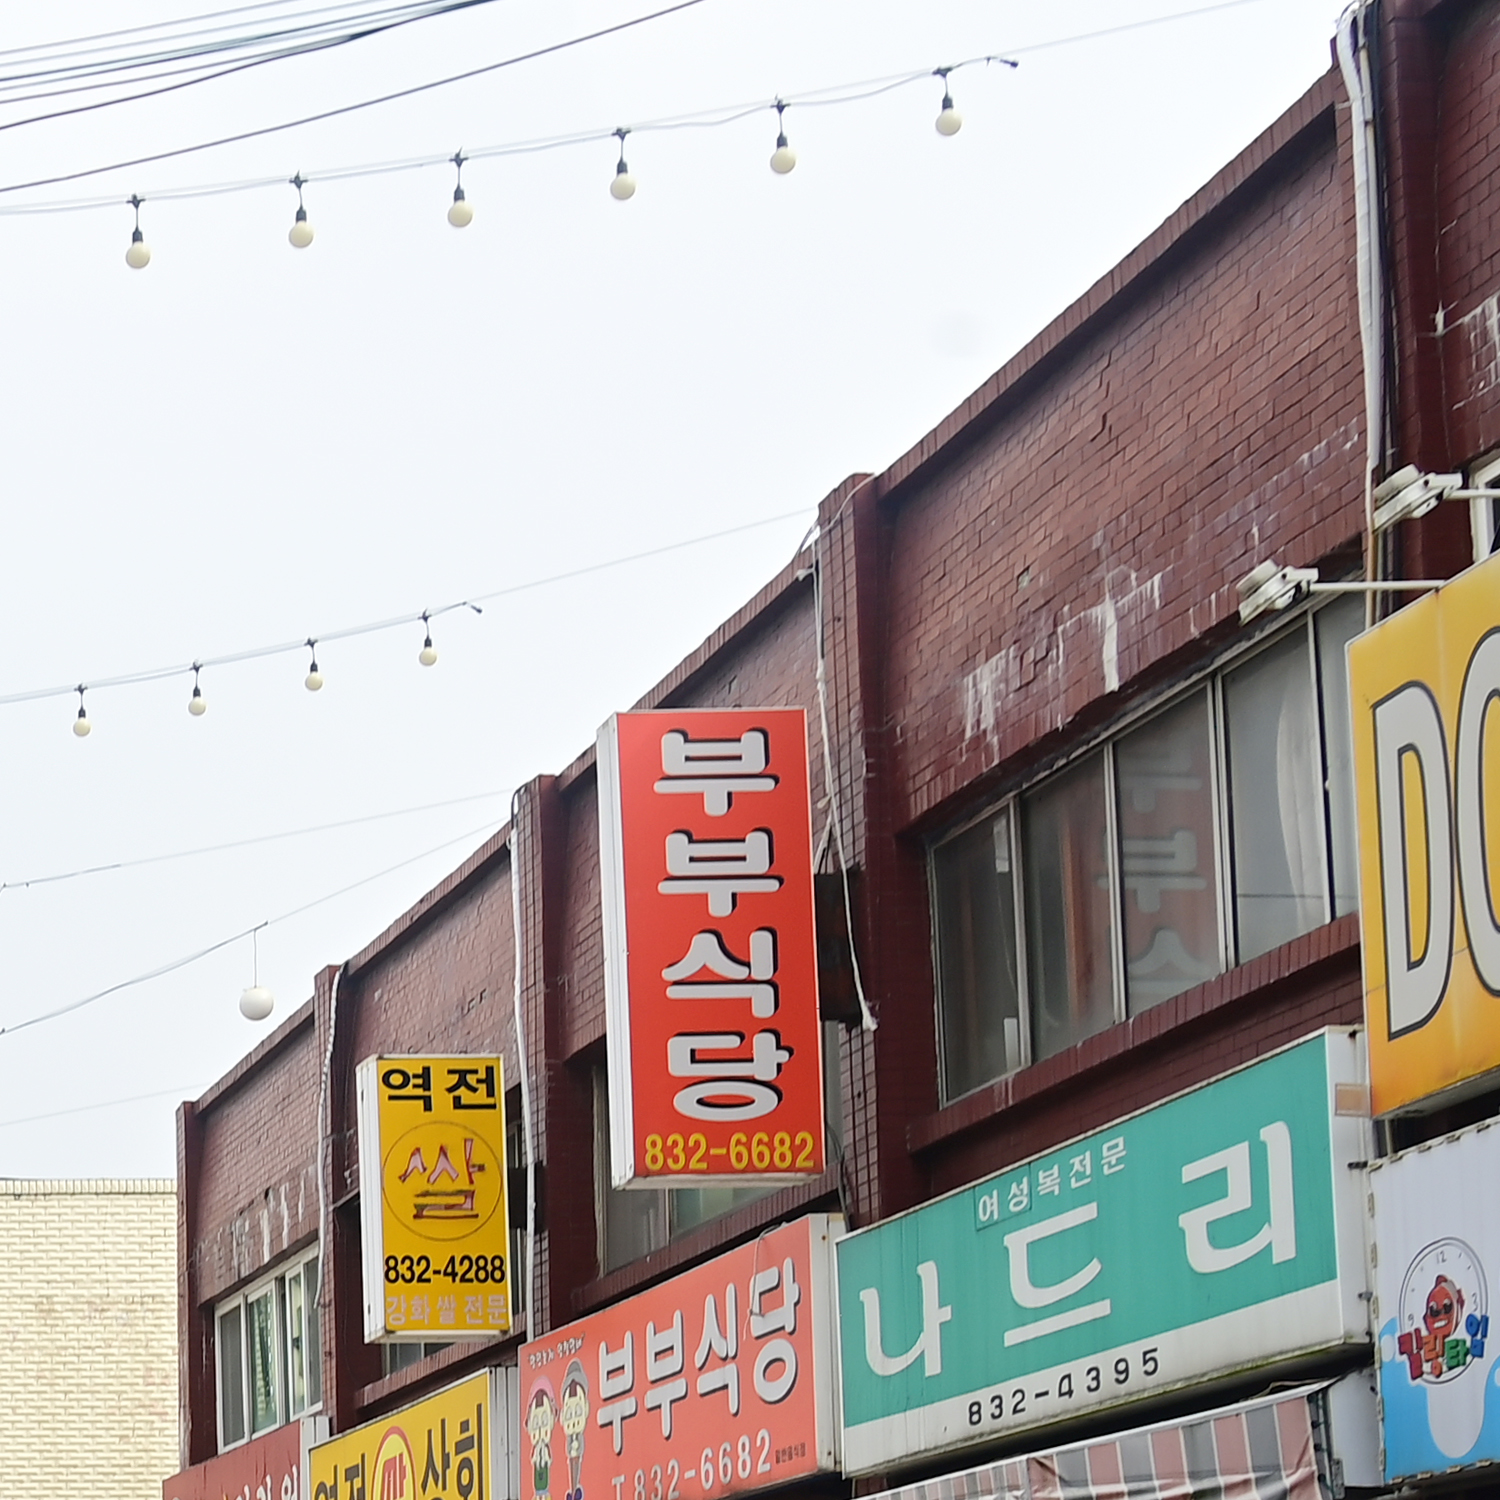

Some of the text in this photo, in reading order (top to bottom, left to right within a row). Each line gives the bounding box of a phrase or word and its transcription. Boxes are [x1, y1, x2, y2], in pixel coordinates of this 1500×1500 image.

[653, 728, 793, 1123] 부부식당
[381, 1065, 499, 1113] 역전
[398, 1136, 487, 1220] 쌀
[643, 1130, 815, 1171] 832-6682
[384, 1253, 507, 1285] 832-4288
[859, 1120, 1297, 1378] 나드리
[596, 1255, 801, 1456] 부부식당
[966, 1346, 1161, 1427] 832-4395
